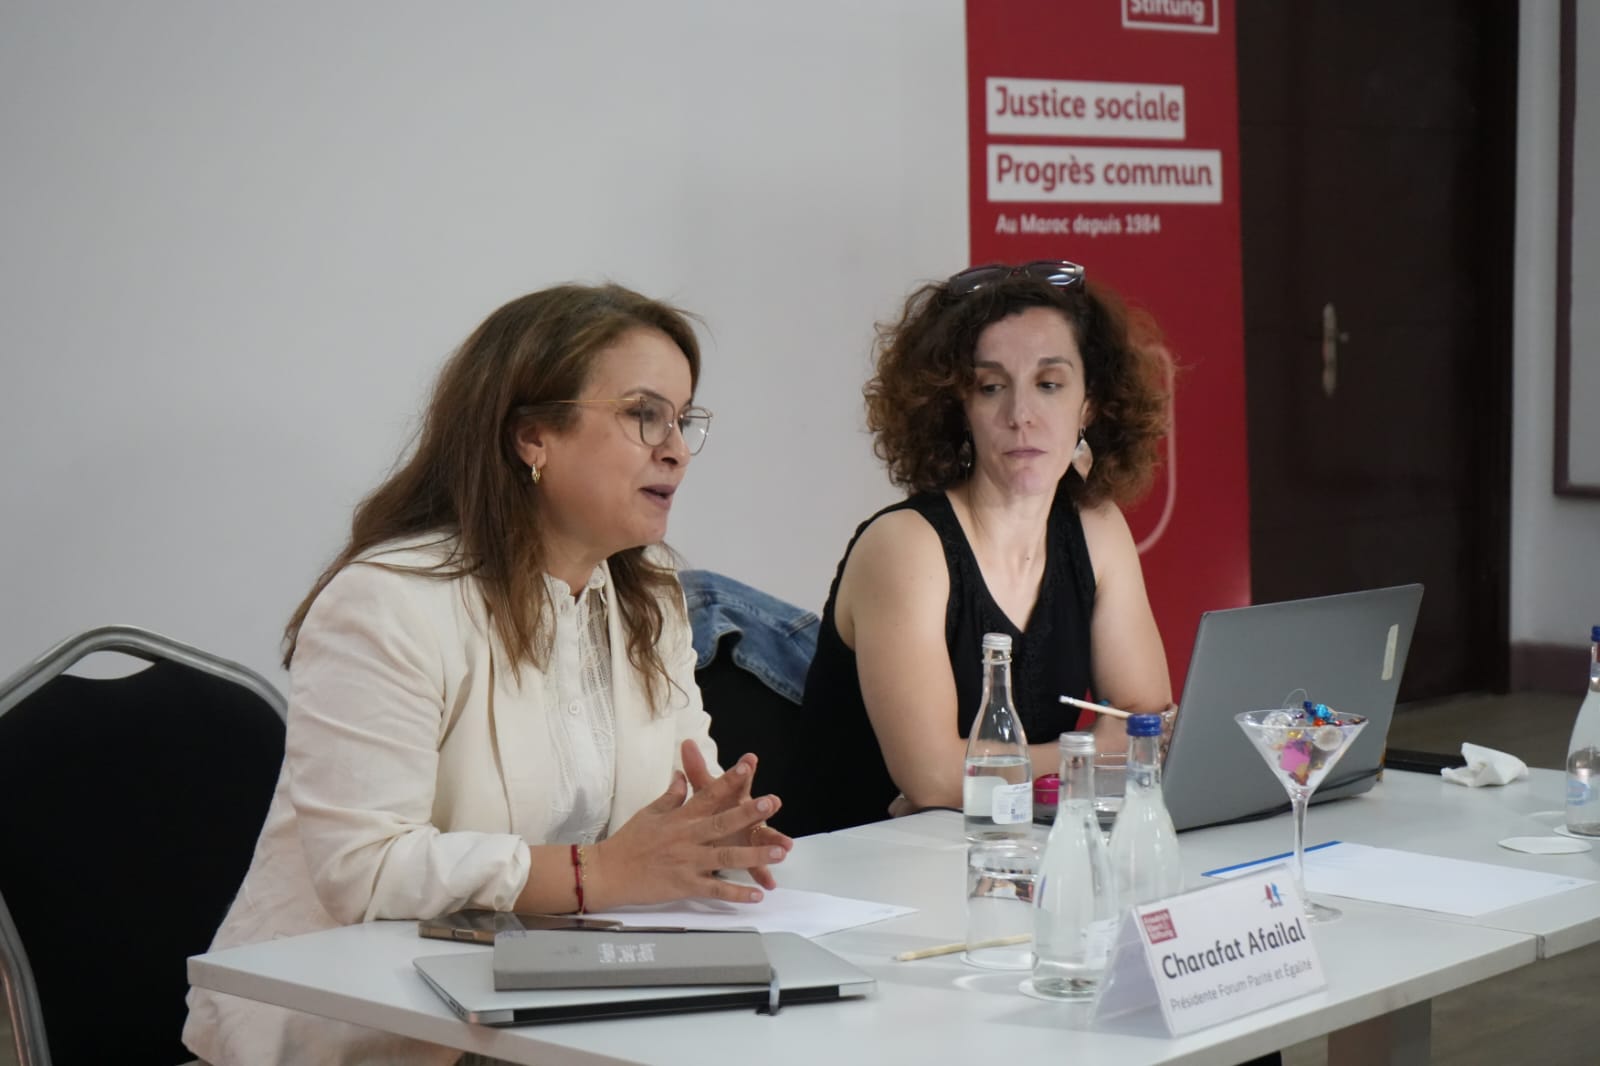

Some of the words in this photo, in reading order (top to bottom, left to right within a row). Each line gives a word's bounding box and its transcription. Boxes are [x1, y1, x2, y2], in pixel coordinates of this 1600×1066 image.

[995, 86, 1086, 119] Justice
[1095, 91, 1181, 123] sociale
[997, 153, 1095, 192] Progrès
[1103, 162, 1213, 187] commun
[995, 214, 1018, 234] Au
[1020, 214, 1069, 234] Maroc
[1072, 214, 1122, 238] depuis
[1125, 214, 1161, 234] 1984
[1162, 940, 1245, 979] Charafat
[1248, 918, 1306, 955] Afailal
[1218, 982, 1247, 997] Forum
[1274, 967, 1284, 980] et
